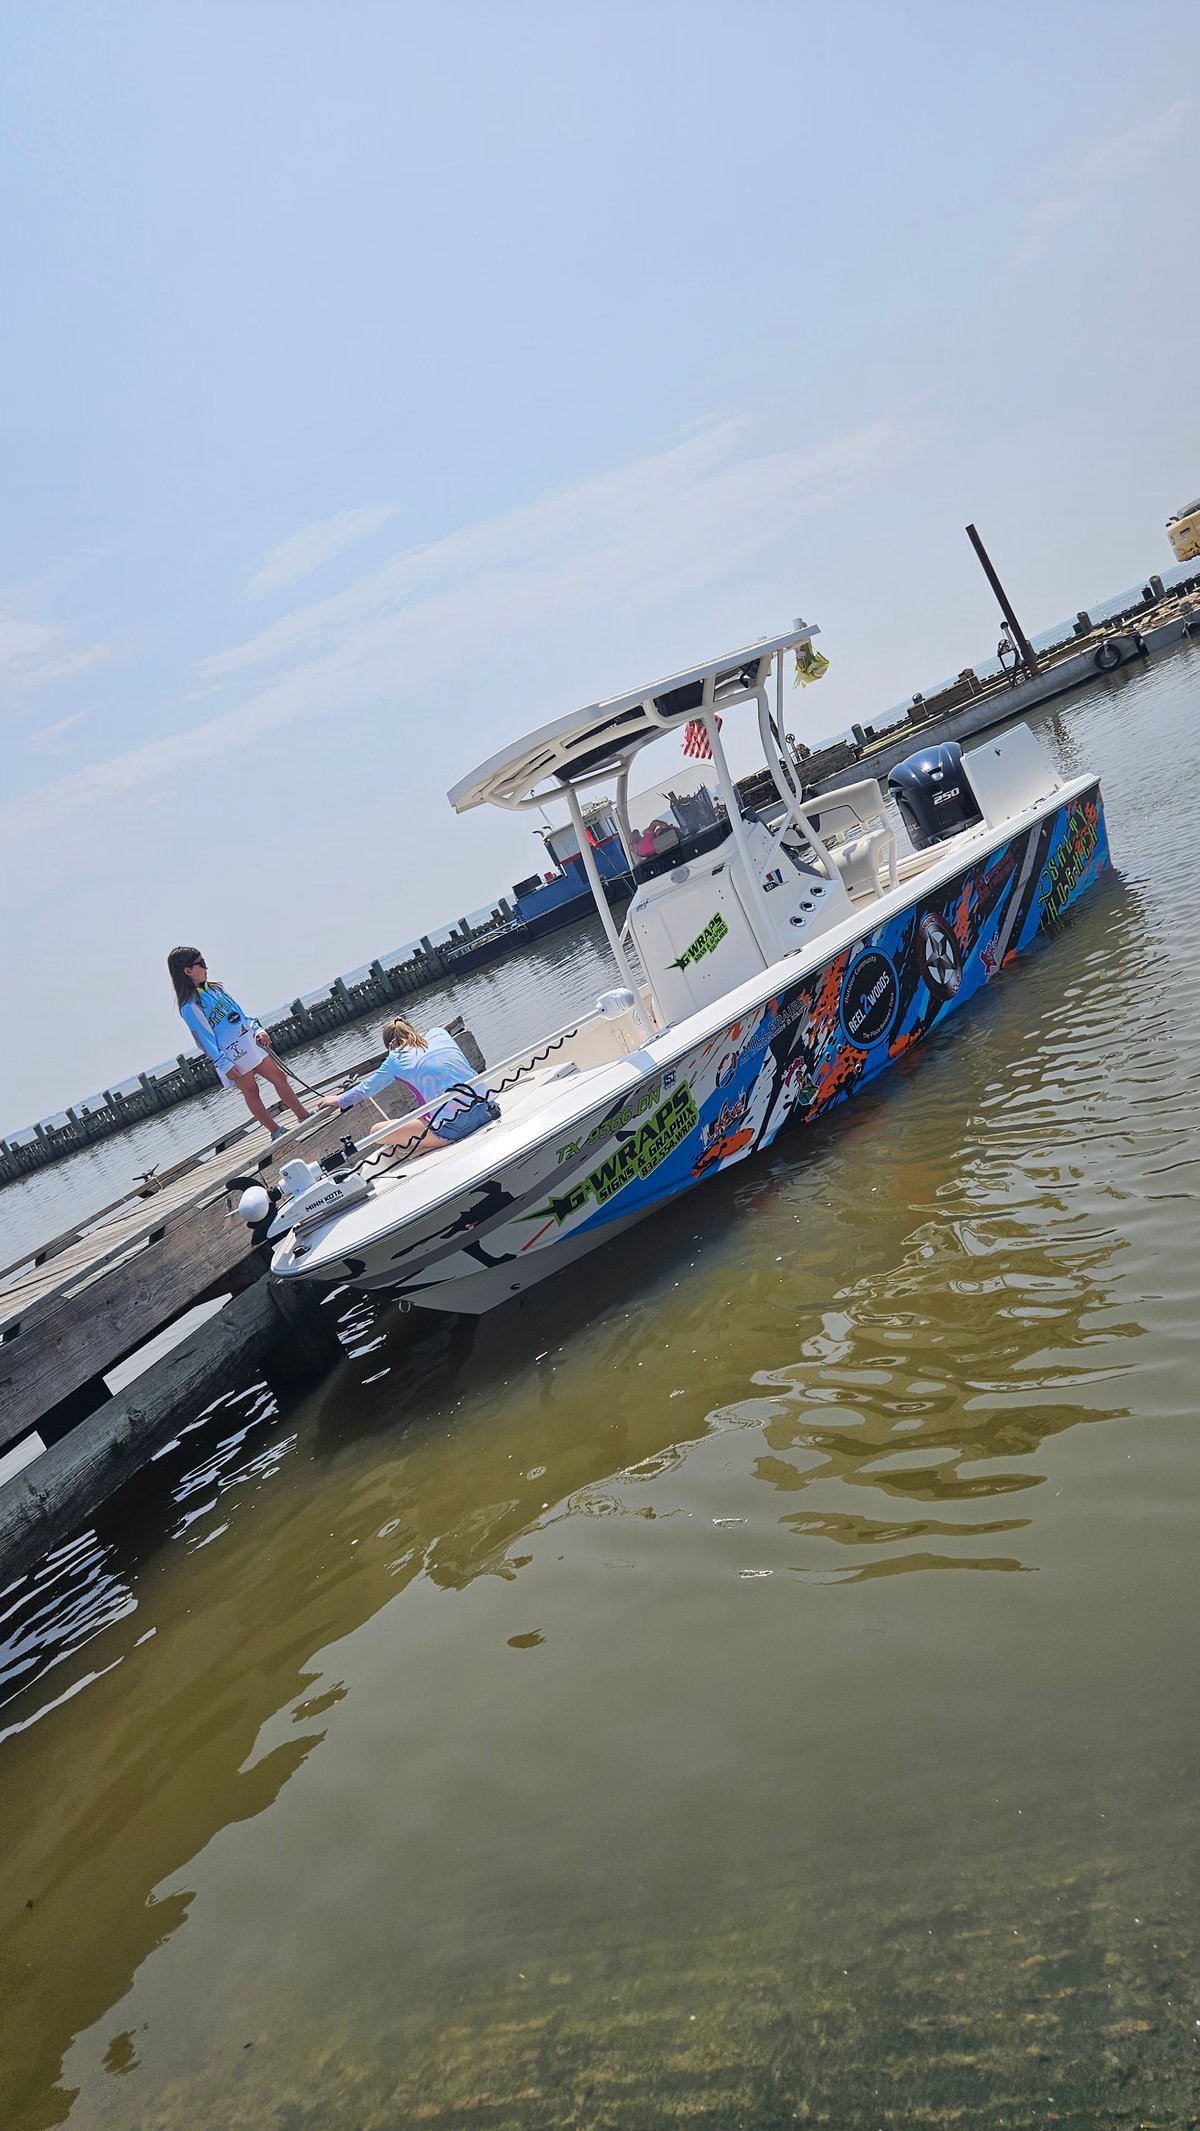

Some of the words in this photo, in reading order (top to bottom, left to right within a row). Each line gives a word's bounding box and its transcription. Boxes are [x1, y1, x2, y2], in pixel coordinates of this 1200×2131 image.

[934, 788, 960, 806] 250
[689, 912, 723, 957] WRAPS
[844, 975, 856, 1003] Outdoor
[855, 956, 876, 975] Community
[848, 1009, 866, 1034] REEL
[860, 994, 872, 1014] 2
[868, 971, 889, 1006] WOODS
[556, 1136, 582, 1164] TX
[588, 1105, 632, 1146] 9366
[636, 1086, 662, 1116] DN
[588, 1084, 690, 1191] WRAPS
[600, 1166, 634, 1200] SIGNS
[637, 1154, 647, 1168] &
[650, 1104, 696, 1158] GRAPHIX
[642, 1116, 698, 1177] 832.554.WRAP
[305, 1200, 324, 1212] MINN
[324, 1189, 342, 1202] KOTA
